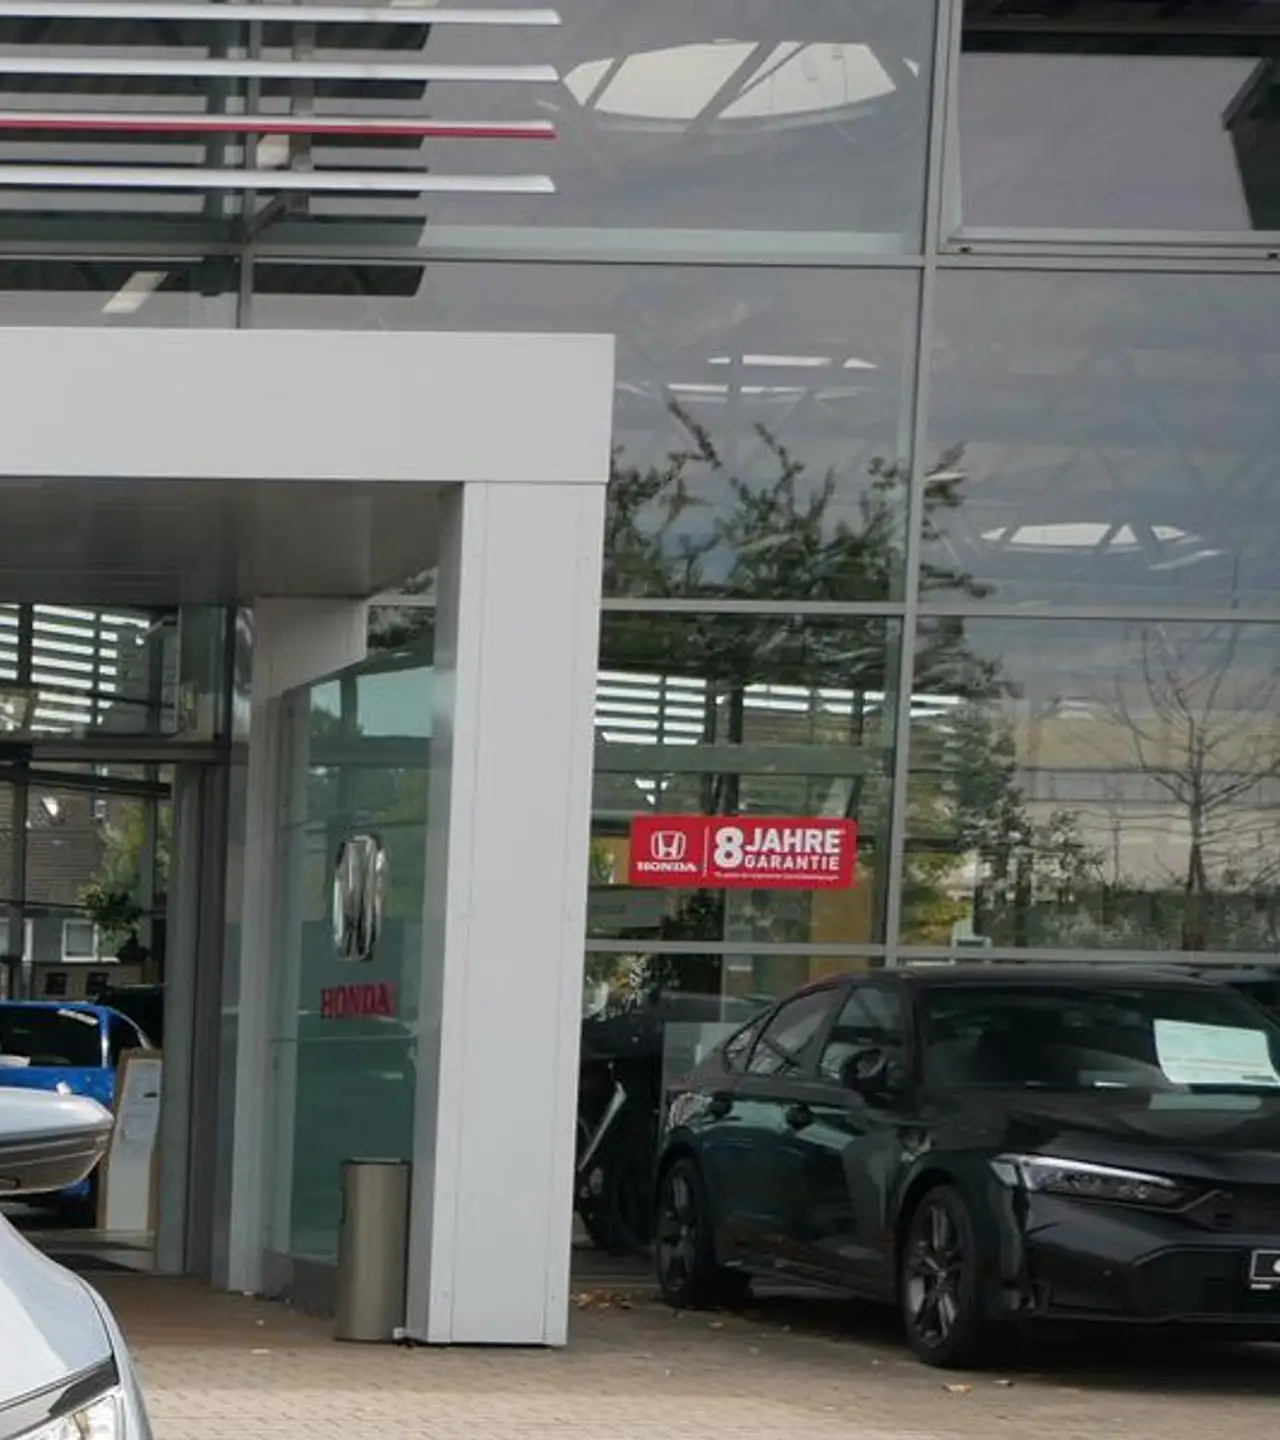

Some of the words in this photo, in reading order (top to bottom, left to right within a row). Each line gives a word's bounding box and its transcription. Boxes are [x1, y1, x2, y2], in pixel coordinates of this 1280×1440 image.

[714, 826, 744, 869] 8
[744, 827, 842, 854] JAHRE
[744, 854, 840, 871] GARANTIE
[320, 983, 395, 1019] HONDA
